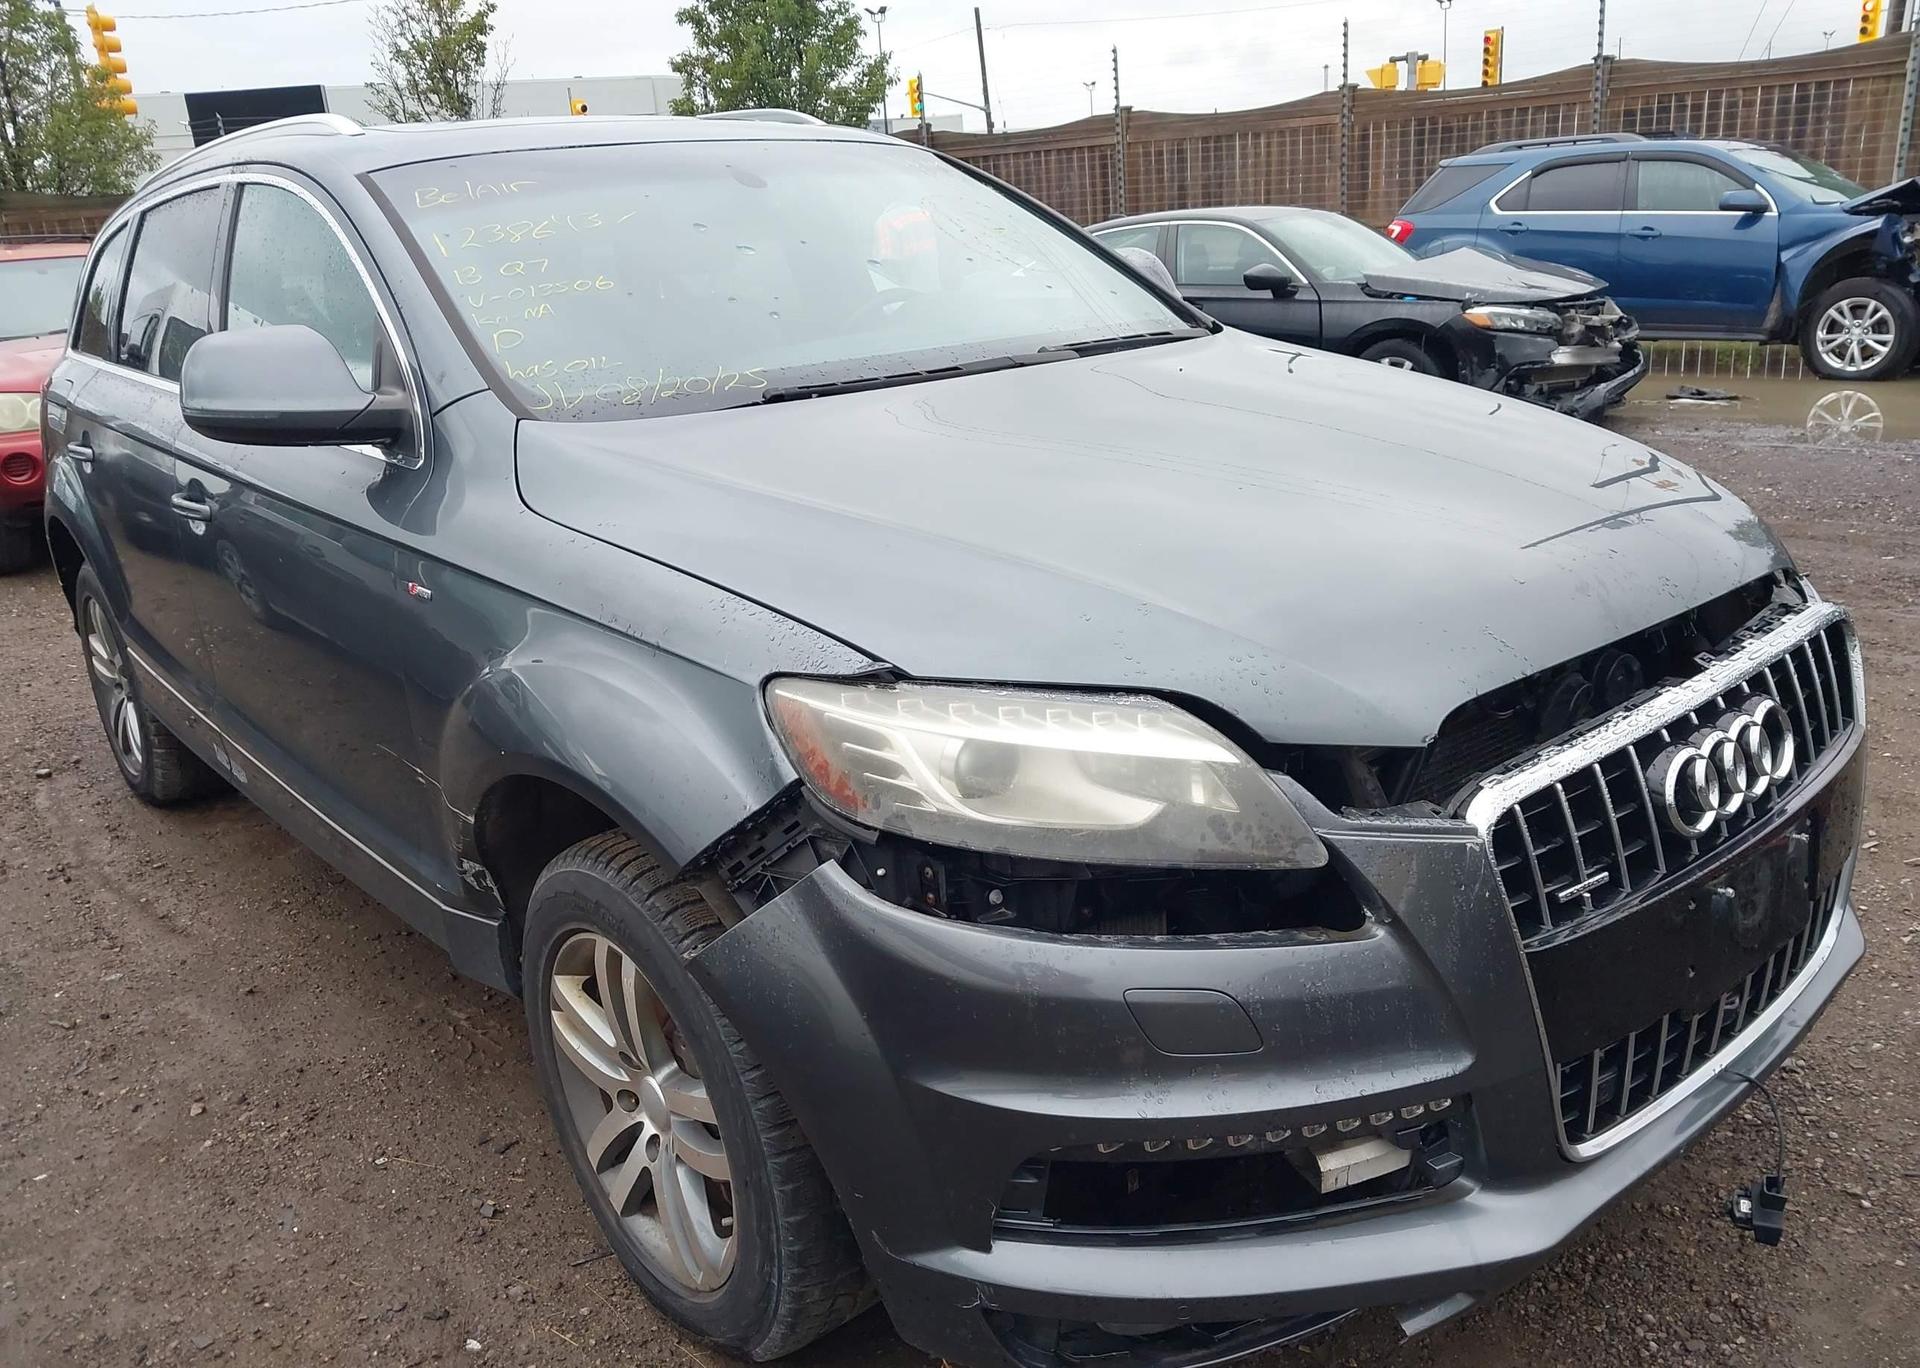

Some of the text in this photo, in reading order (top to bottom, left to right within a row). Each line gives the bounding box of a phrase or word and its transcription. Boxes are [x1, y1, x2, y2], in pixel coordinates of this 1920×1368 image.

[453, 258, 549, 285] 13 Q7
[595, 365, 768, 405] 08/20/25
